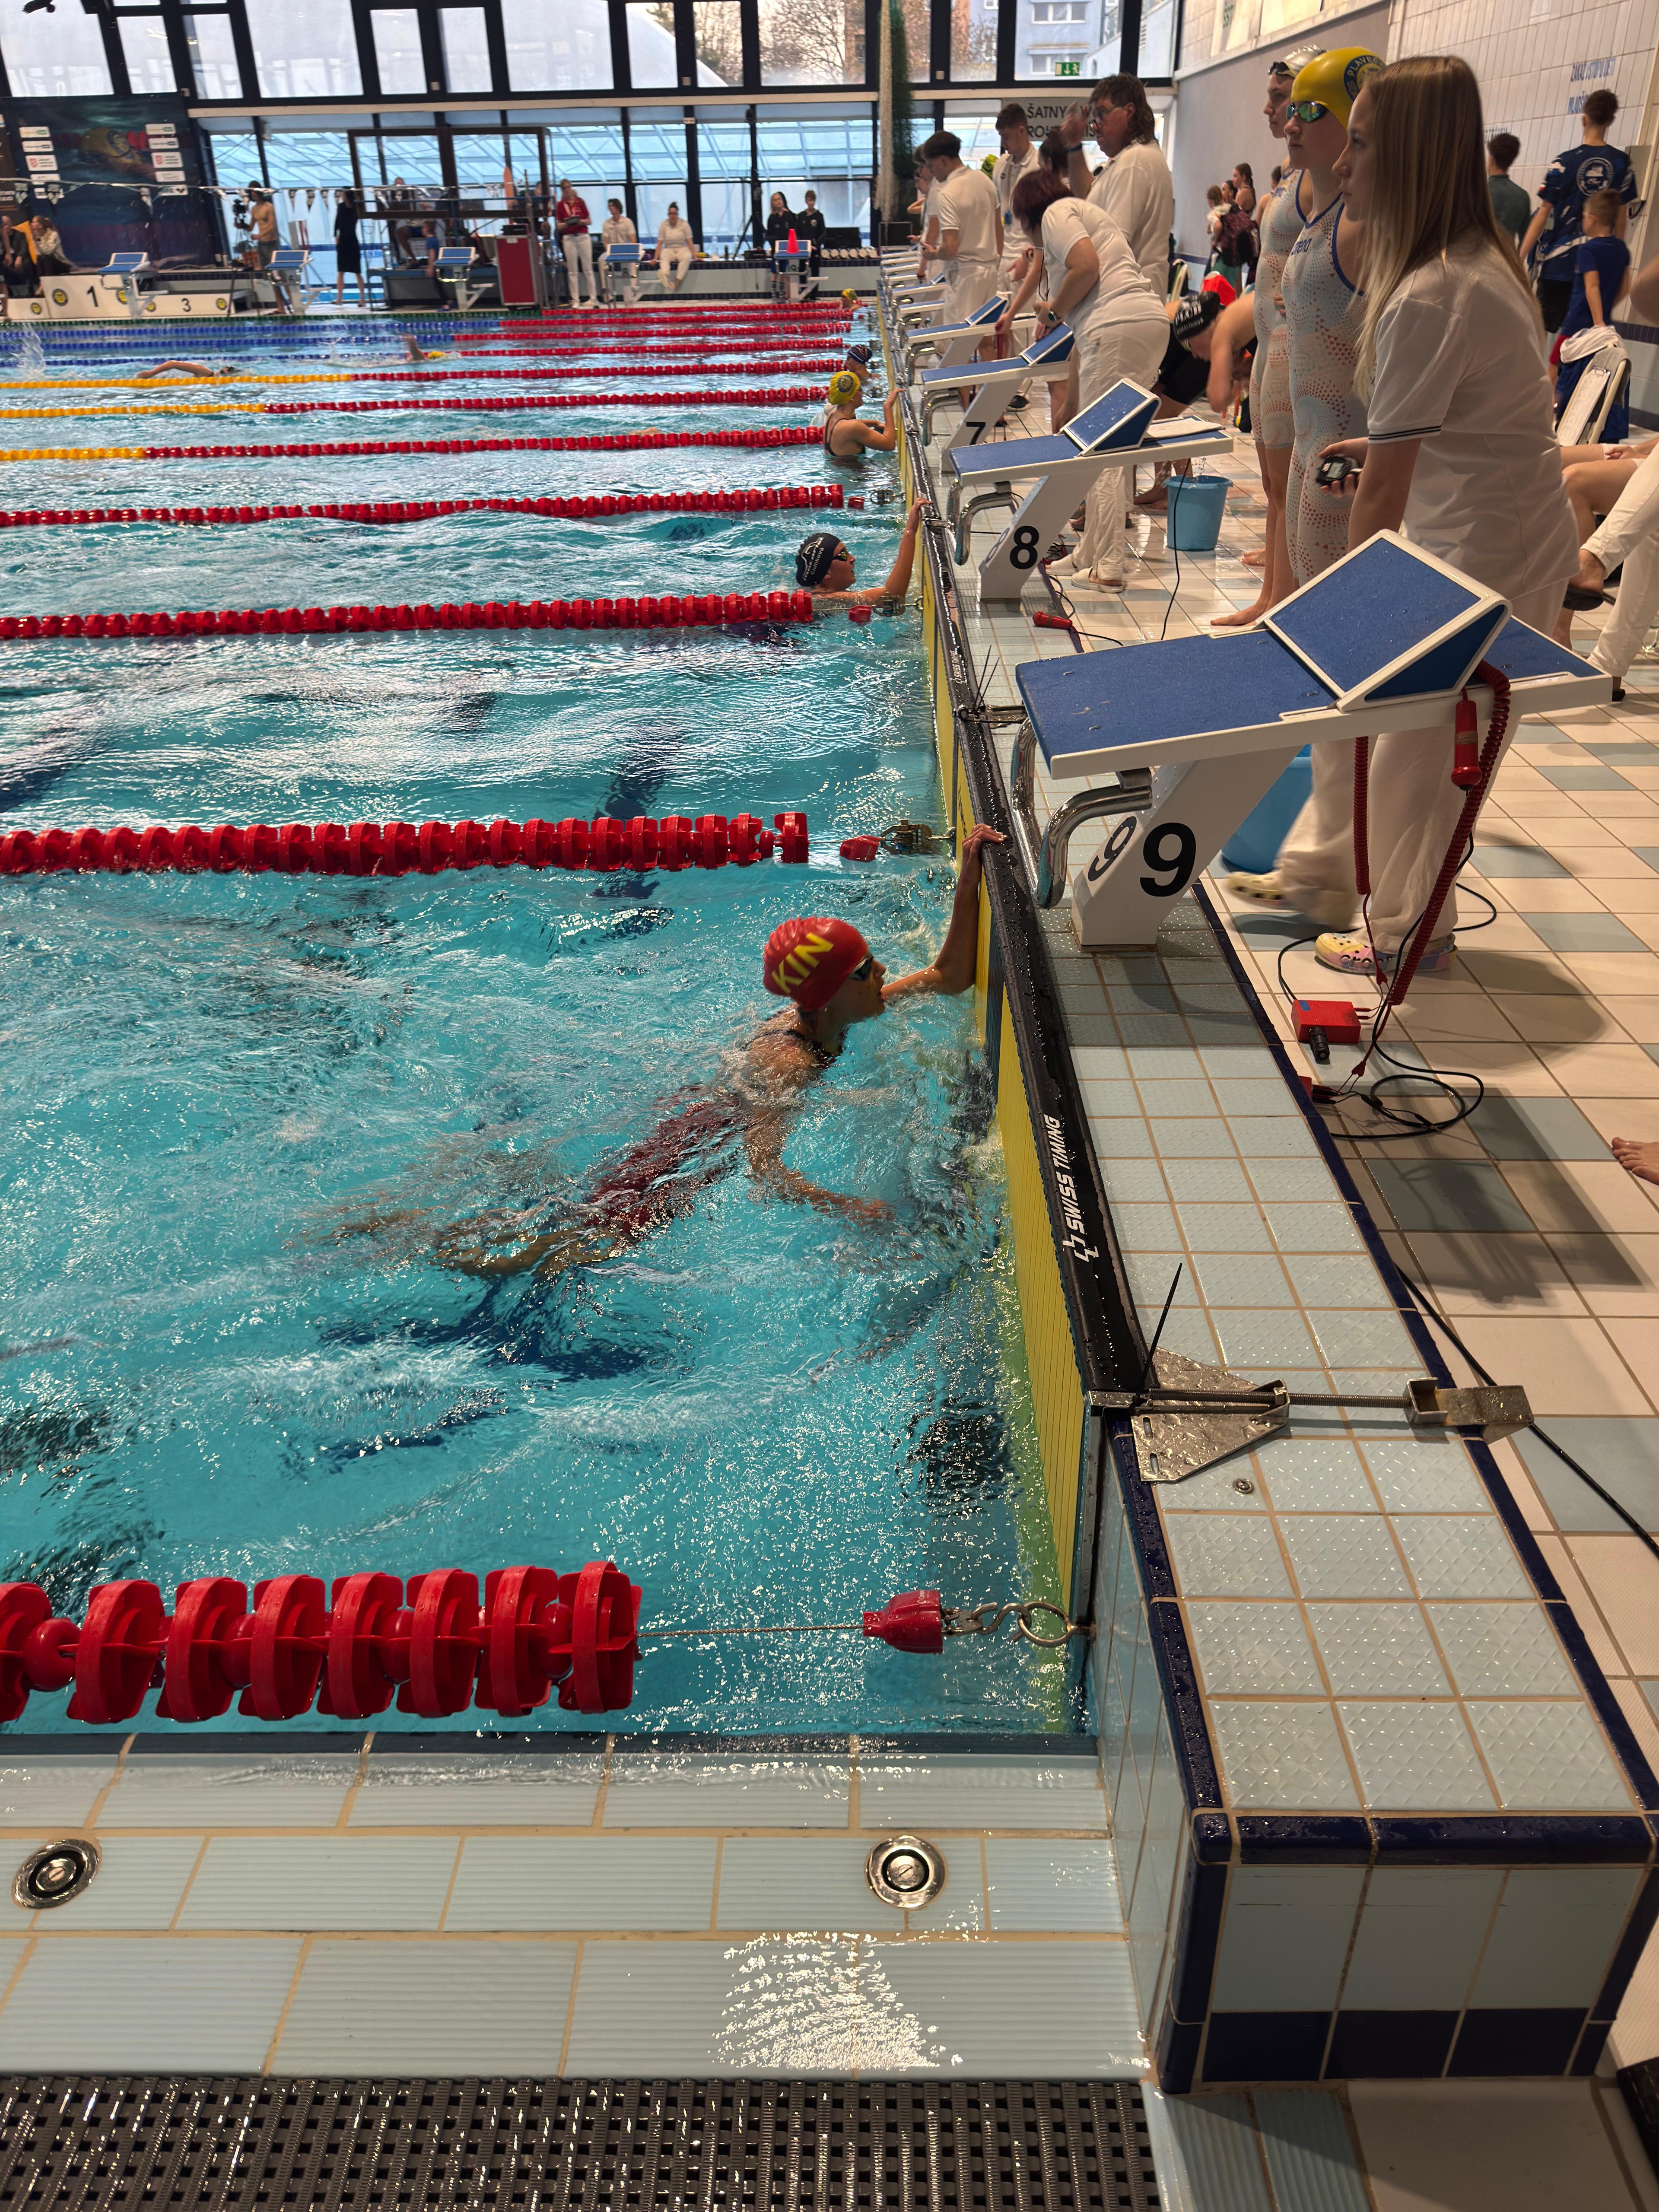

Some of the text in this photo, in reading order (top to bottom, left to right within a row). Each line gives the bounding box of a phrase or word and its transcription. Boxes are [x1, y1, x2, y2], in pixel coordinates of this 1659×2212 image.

[1027, 103, 1068, 118] ŠATNY
[87, 286, 98, 307] 1
[181, 298, 191, 312] 3
[966, 422, 986, 445] 7
[1010, 525, 1039, 570] 8
[952, 664, 962, 678] SWISS
[1088, 816, 1137, 882] 9
[1140, 822, 1196, 897] 9
[771, 932, 834, 994] KIN
[1044, 1115, 1085, 1234] SWISS TIMING
